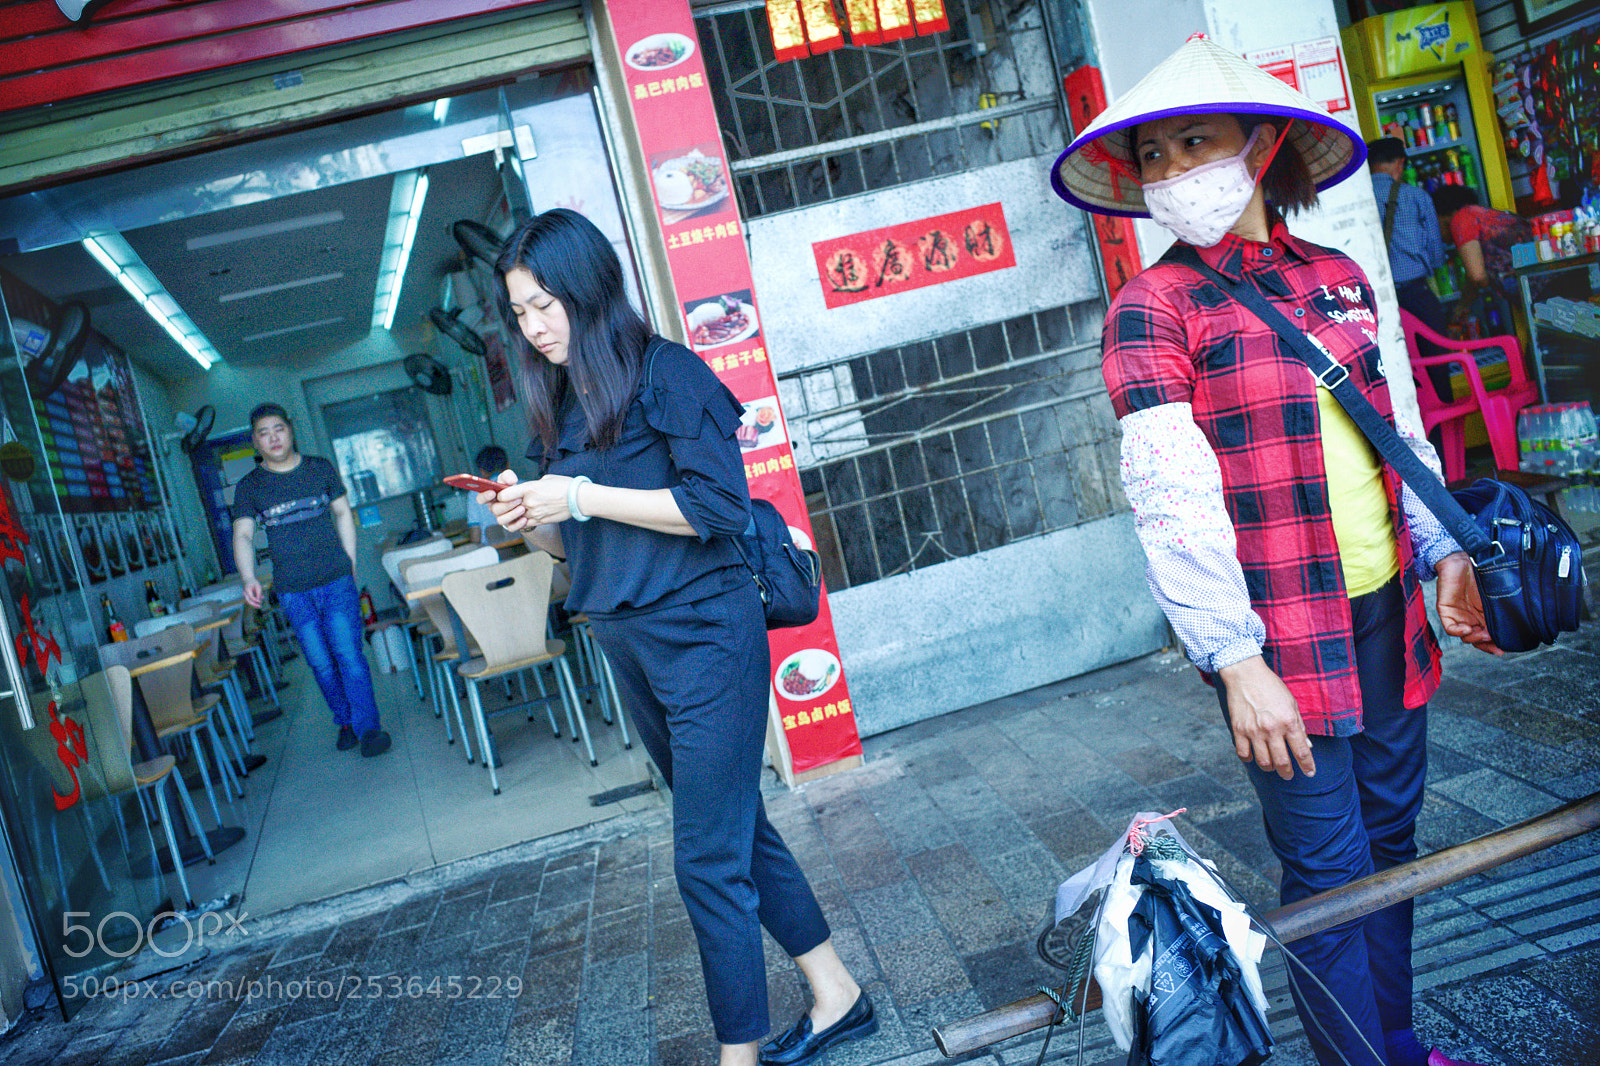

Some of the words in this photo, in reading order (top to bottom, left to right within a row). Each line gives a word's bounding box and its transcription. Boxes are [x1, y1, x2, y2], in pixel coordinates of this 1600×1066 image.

[668, 220, 739, 249] 土豆烧牛肉饭
[705, 347, 767, 372] 香茄子饭
[783, 698, 852, 730] 宝岛卤肉饭
